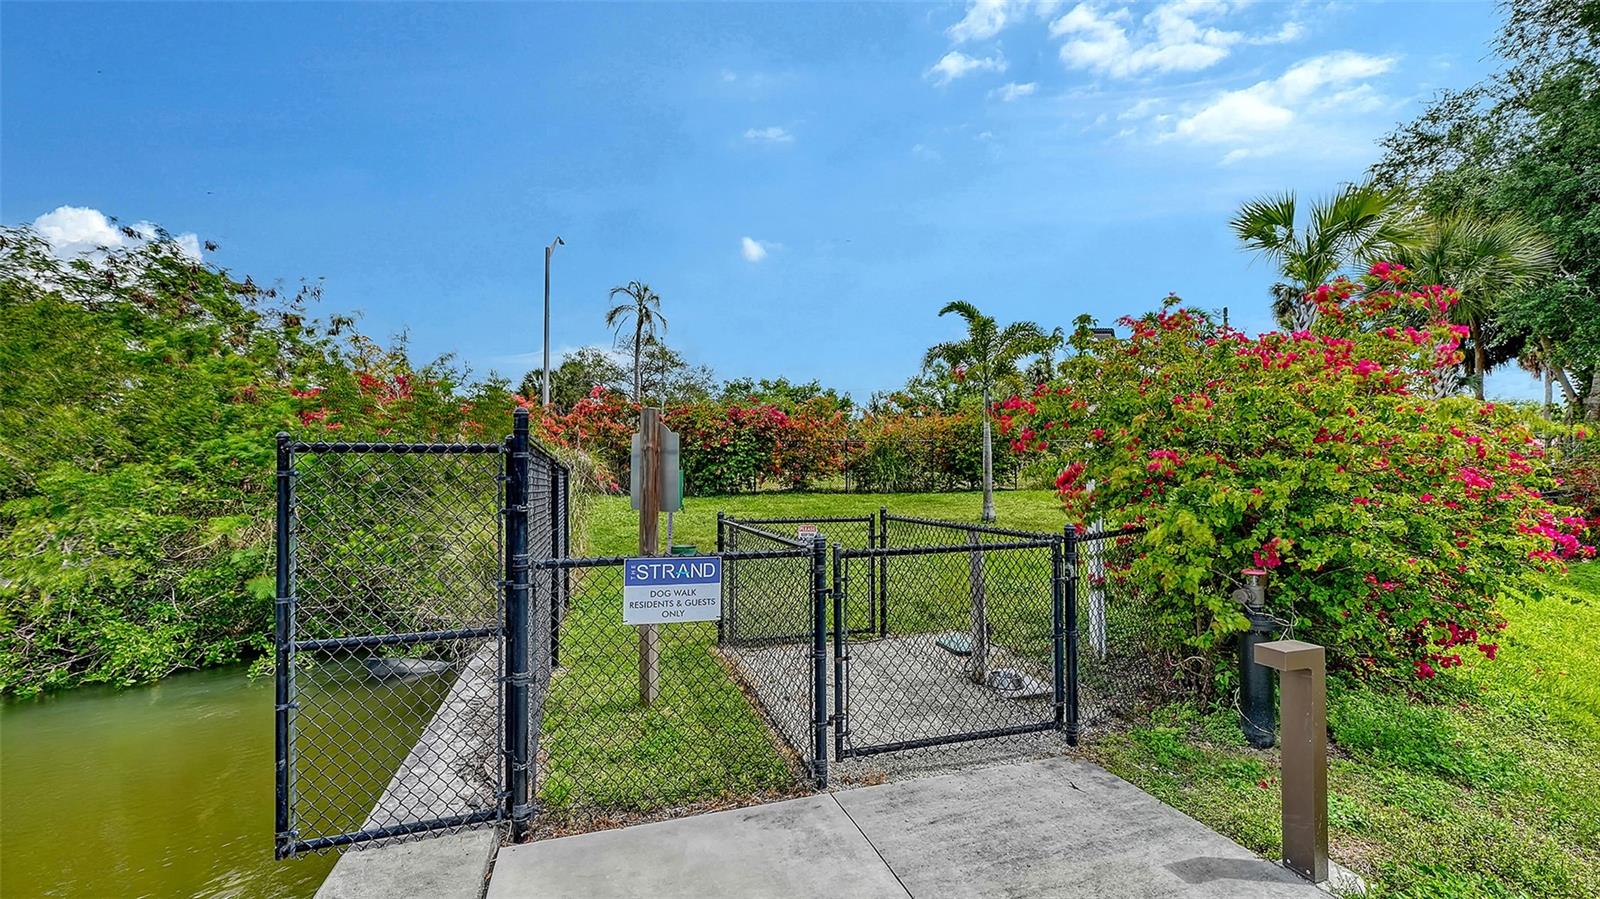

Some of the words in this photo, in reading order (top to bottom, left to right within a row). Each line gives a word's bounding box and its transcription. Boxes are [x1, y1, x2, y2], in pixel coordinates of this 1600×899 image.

[636, 563, 716, 580] STRAND
[650, 590, 671, 598] DOG
[674, 589, 697, 597] WALK
[629, 600, 674, 609] RESIDENTS
[676, 600, 682, 608] &
[685, 598, 716, 607] GUESTS
[662, 610, 685, 618] ONLY
